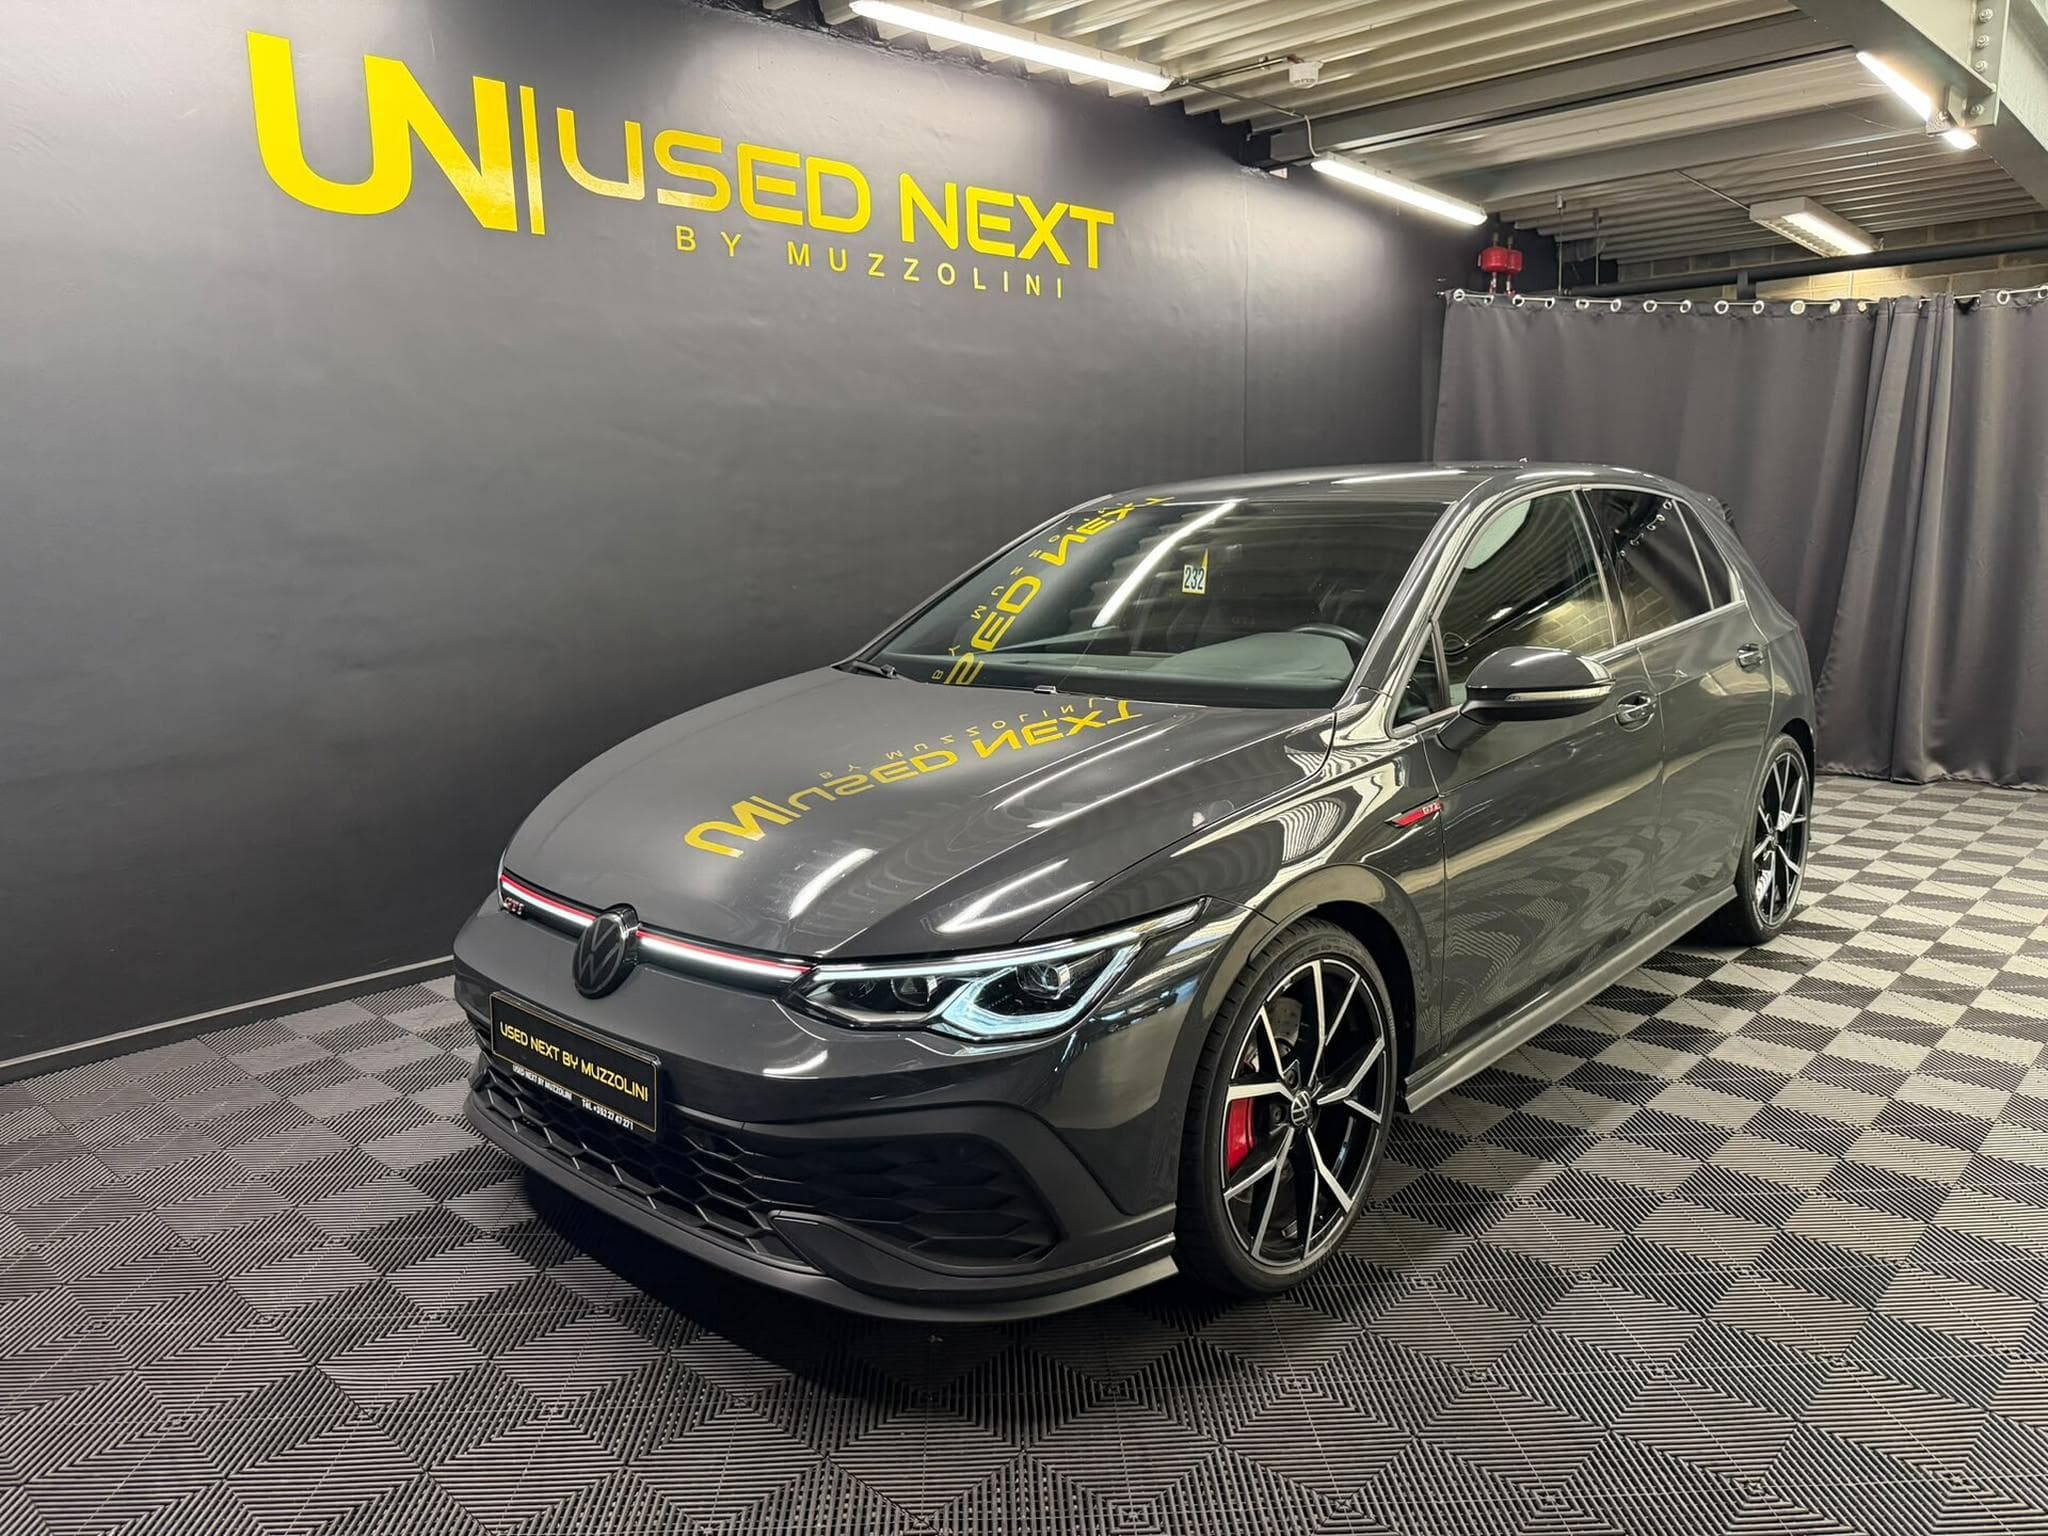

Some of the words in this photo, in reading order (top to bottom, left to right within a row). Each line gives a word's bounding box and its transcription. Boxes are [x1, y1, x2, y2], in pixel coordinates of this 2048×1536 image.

[556, 107, 872, 234] USED
[900, 172, 1114, 269] NEXT
[675, 224, 742, 257] BY
[786, 240, 1062, 298] MUZZOLINI
[1184, 566, 1205, 590] 232
[500, 1021, 529, 1047] USED
[530, 1035, 560, 1062] NEXT
[562, 1050, 579, 1070] BY
[581, 1059, 649, 1102] MUZZOLINI
